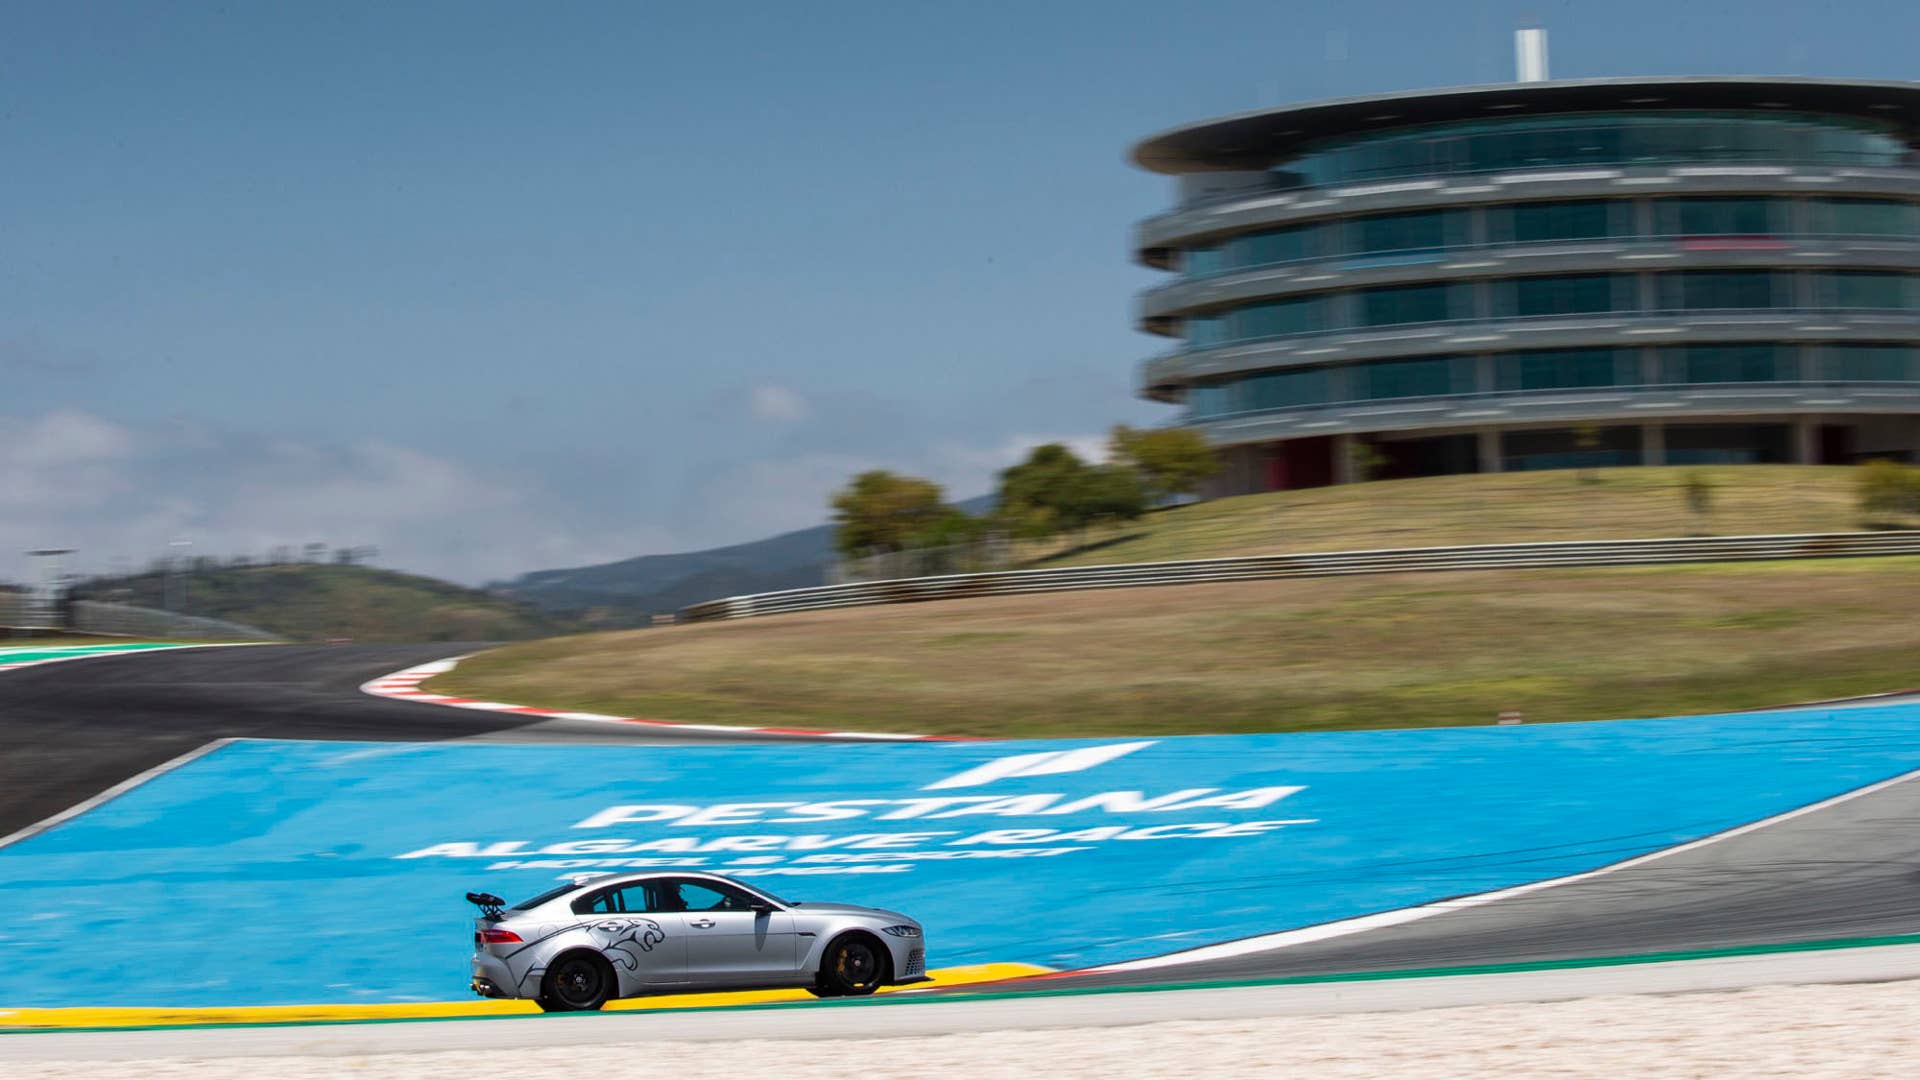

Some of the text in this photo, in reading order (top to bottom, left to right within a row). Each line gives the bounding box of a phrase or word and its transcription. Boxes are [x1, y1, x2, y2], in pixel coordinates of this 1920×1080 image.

[571, 785, 1308, 829] PESTANA
[391, 818, 1320, 859] ALGARVE RACE
[484, 855, 714, 870] HOTEL
[791, 846, 1099, 864] RESORT
